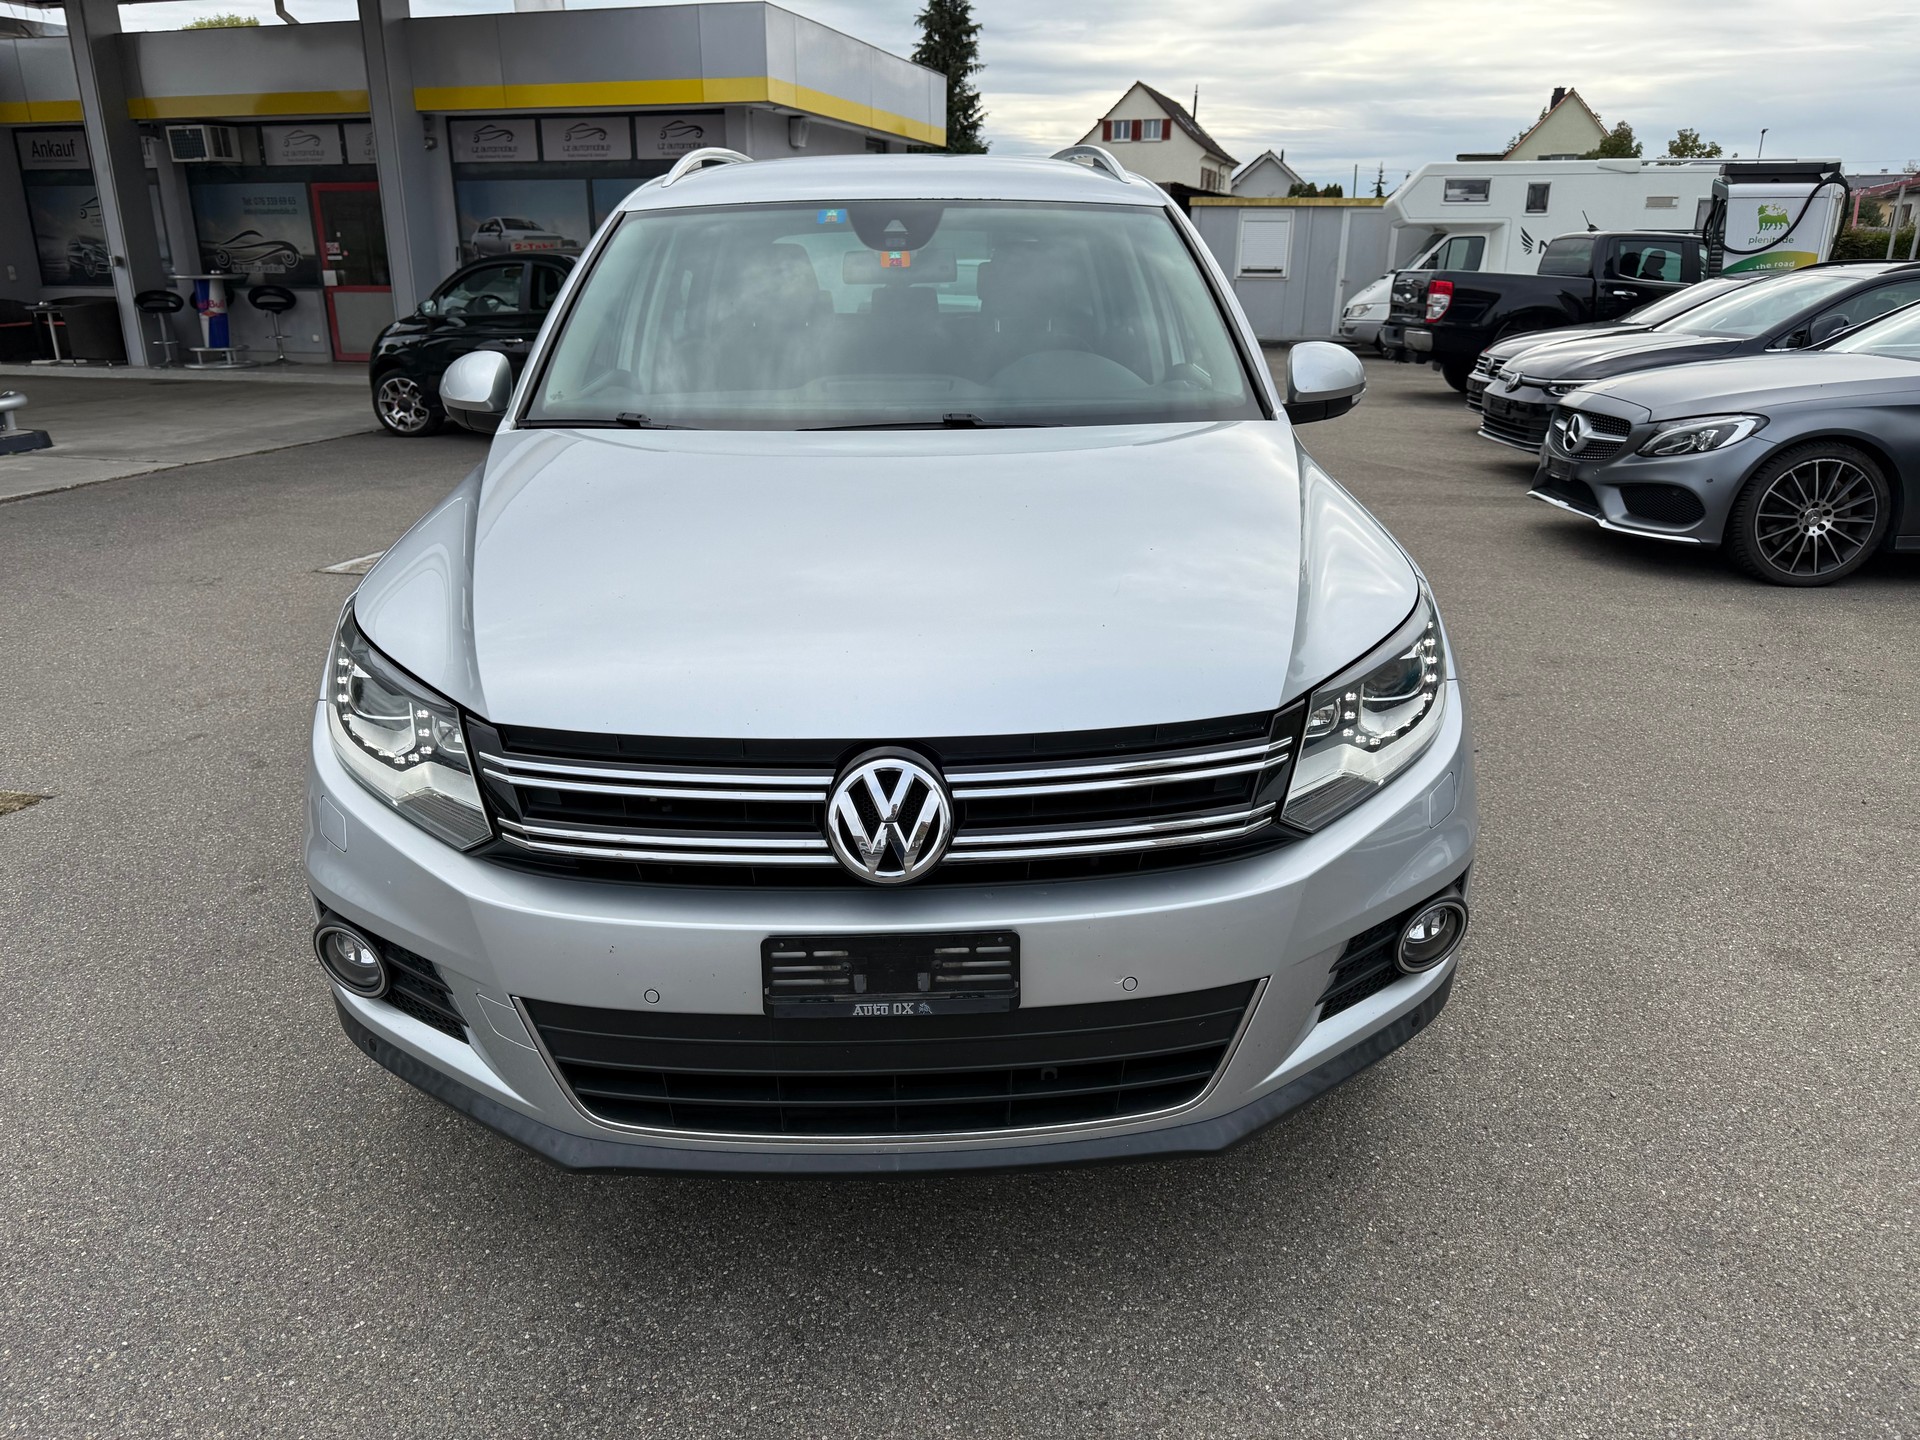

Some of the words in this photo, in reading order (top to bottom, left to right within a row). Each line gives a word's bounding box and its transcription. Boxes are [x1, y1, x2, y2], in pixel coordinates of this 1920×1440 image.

[32, 138, 76, 158] Ankauf
[1748, 236, 1794, 245] plenitde
[1774, 260, 1796, 268] road
[852, 1003, 890, 1016] Auto
[893, 1002, 914, 1015] OX
